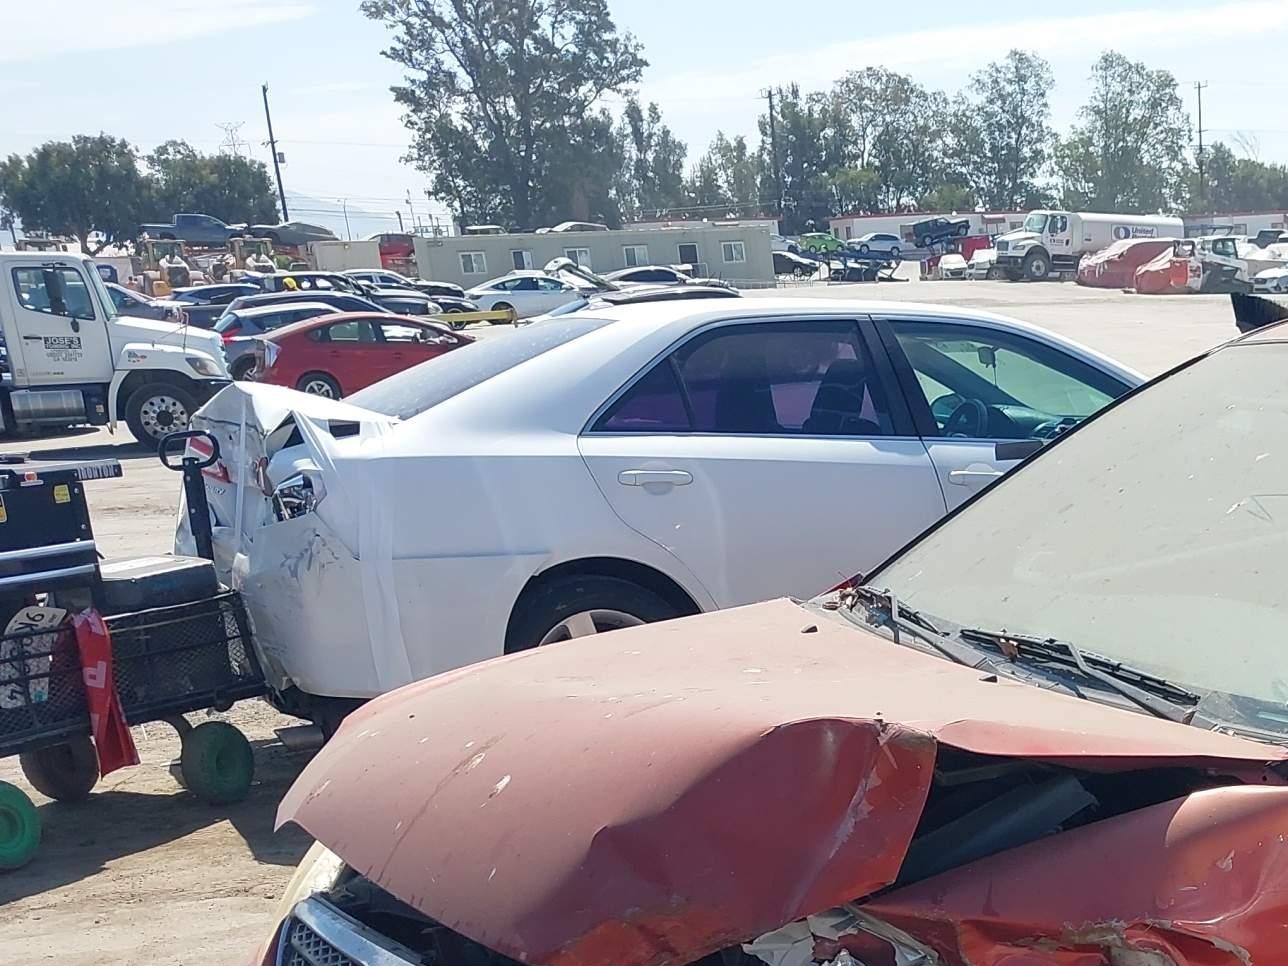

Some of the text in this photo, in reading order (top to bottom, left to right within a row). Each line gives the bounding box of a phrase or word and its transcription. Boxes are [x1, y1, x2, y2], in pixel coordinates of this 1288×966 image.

[1131, 227, 1154, 235] United
[46, 336, 79, 345] JOSE'S
[78, 464, 115, 480] IRONTON
